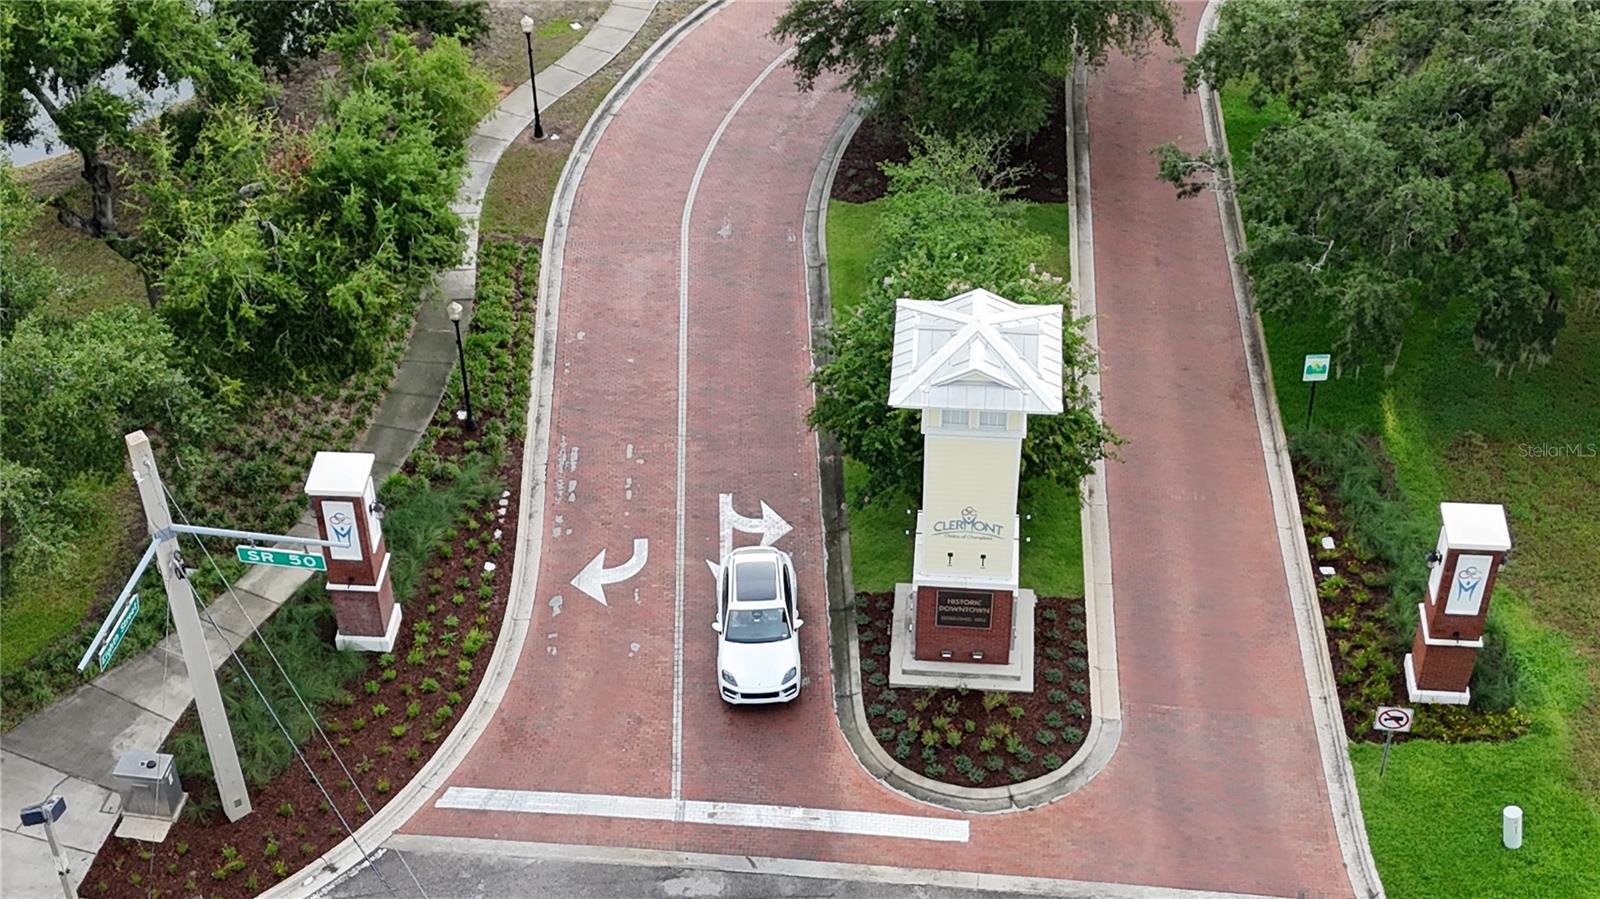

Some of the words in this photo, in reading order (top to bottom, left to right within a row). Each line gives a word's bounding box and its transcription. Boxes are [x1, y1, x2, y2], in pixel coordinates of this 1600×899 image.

[933, 518, 1004, 536] CLERMONT
[247, 550, 274, 563] SR
[288, 554, 317, 567] 50
[947, 598, 982, 606] HISTORIC
[938, 605, 991, 615] DOWNTOWN
